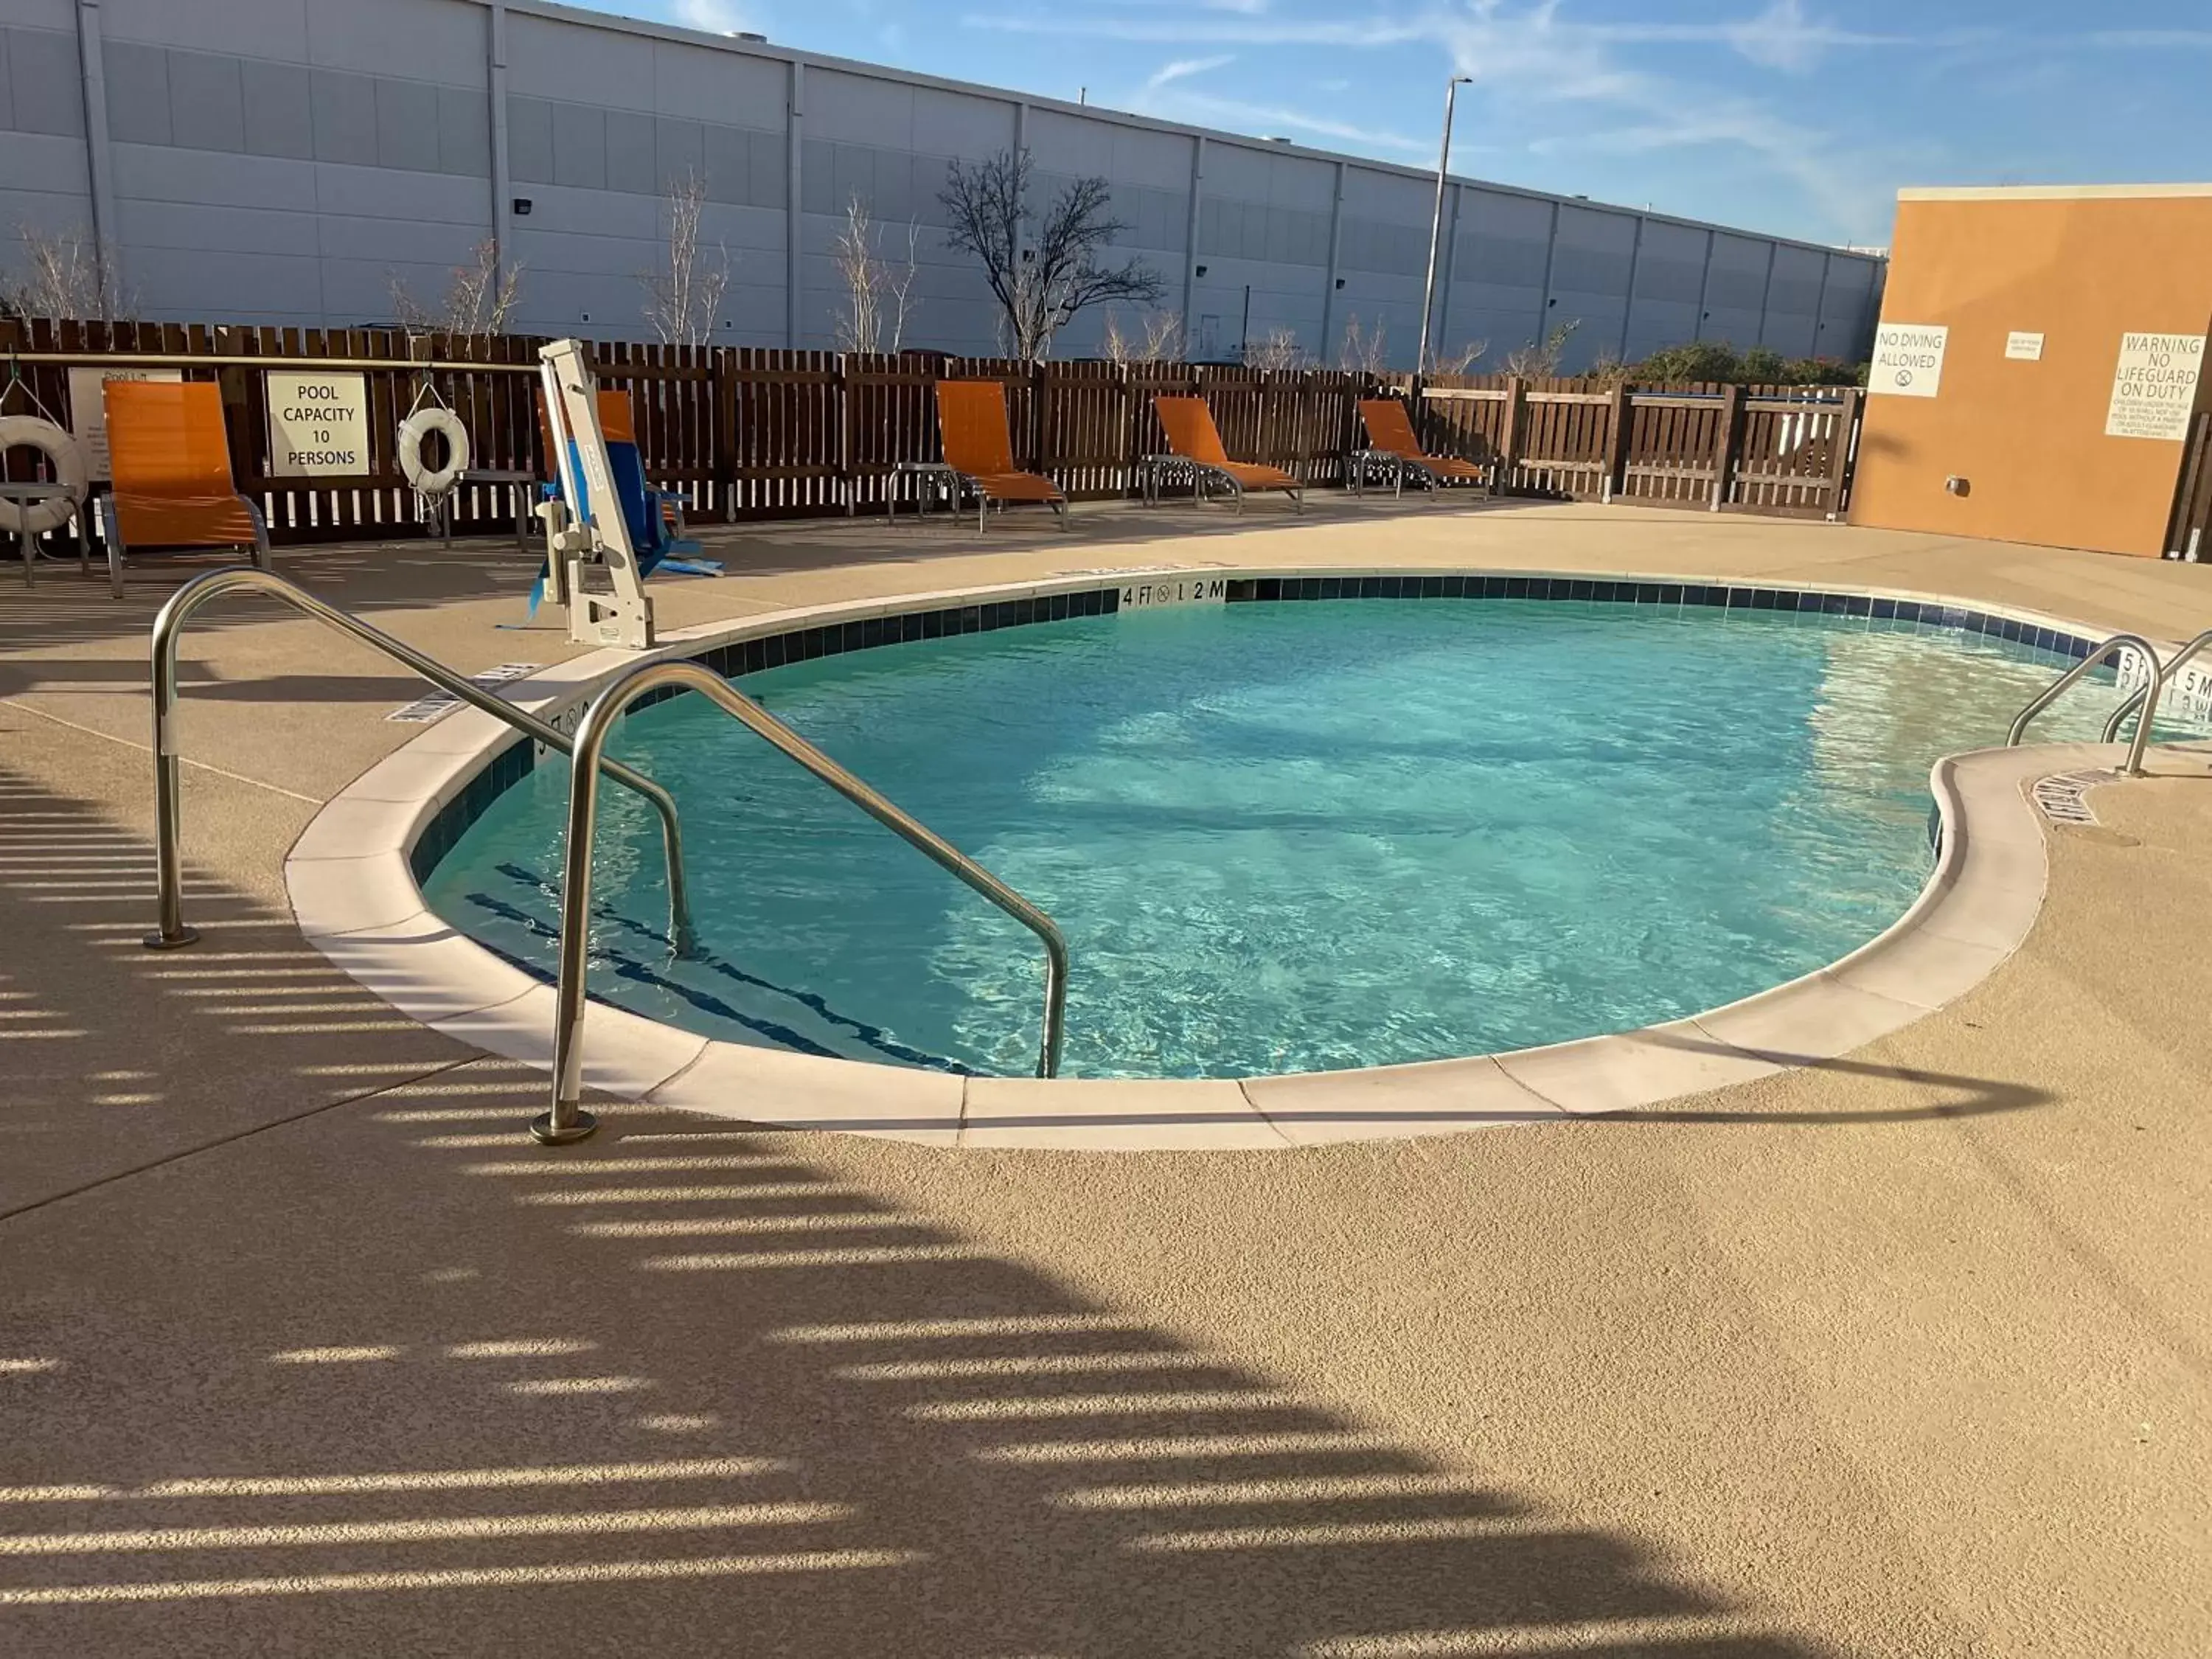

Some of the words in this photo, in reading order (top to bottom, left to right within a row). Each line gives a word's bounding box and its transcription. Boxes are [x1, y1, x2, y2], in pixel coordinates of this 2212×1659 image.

[1879, 333, 1899, 346] NO
[1900, 333, 1943, 349] DIVING
[2126, 336, 2200, 353] WARNING
[1878, 353, 1935, 368] ALLOWED
[2148, 353, 2170, 367] NO
[2118, 367, 2197, 384] LIFEGUARD
[298, 386, 339, 400] POOL
[2121, 383, 2143, 397] ON
[2146, 384, 2188, 399] DUTY
[283, 408, 355, 421] CAPACITY
[313, 430, 330, 443] 10
[288, 451, 355, 465] PERSONS
[1123, 587, 1132, 605] 4
[1139, 586, 1152, 605] FT
[1194, 582, 1203, 599] 2
[1209, 580, 1223, 598] M
[2124, 653, 2133, 672] 5
[2185, 672, 2196, 691] 5
[2198, 675, 2212, 699] M
